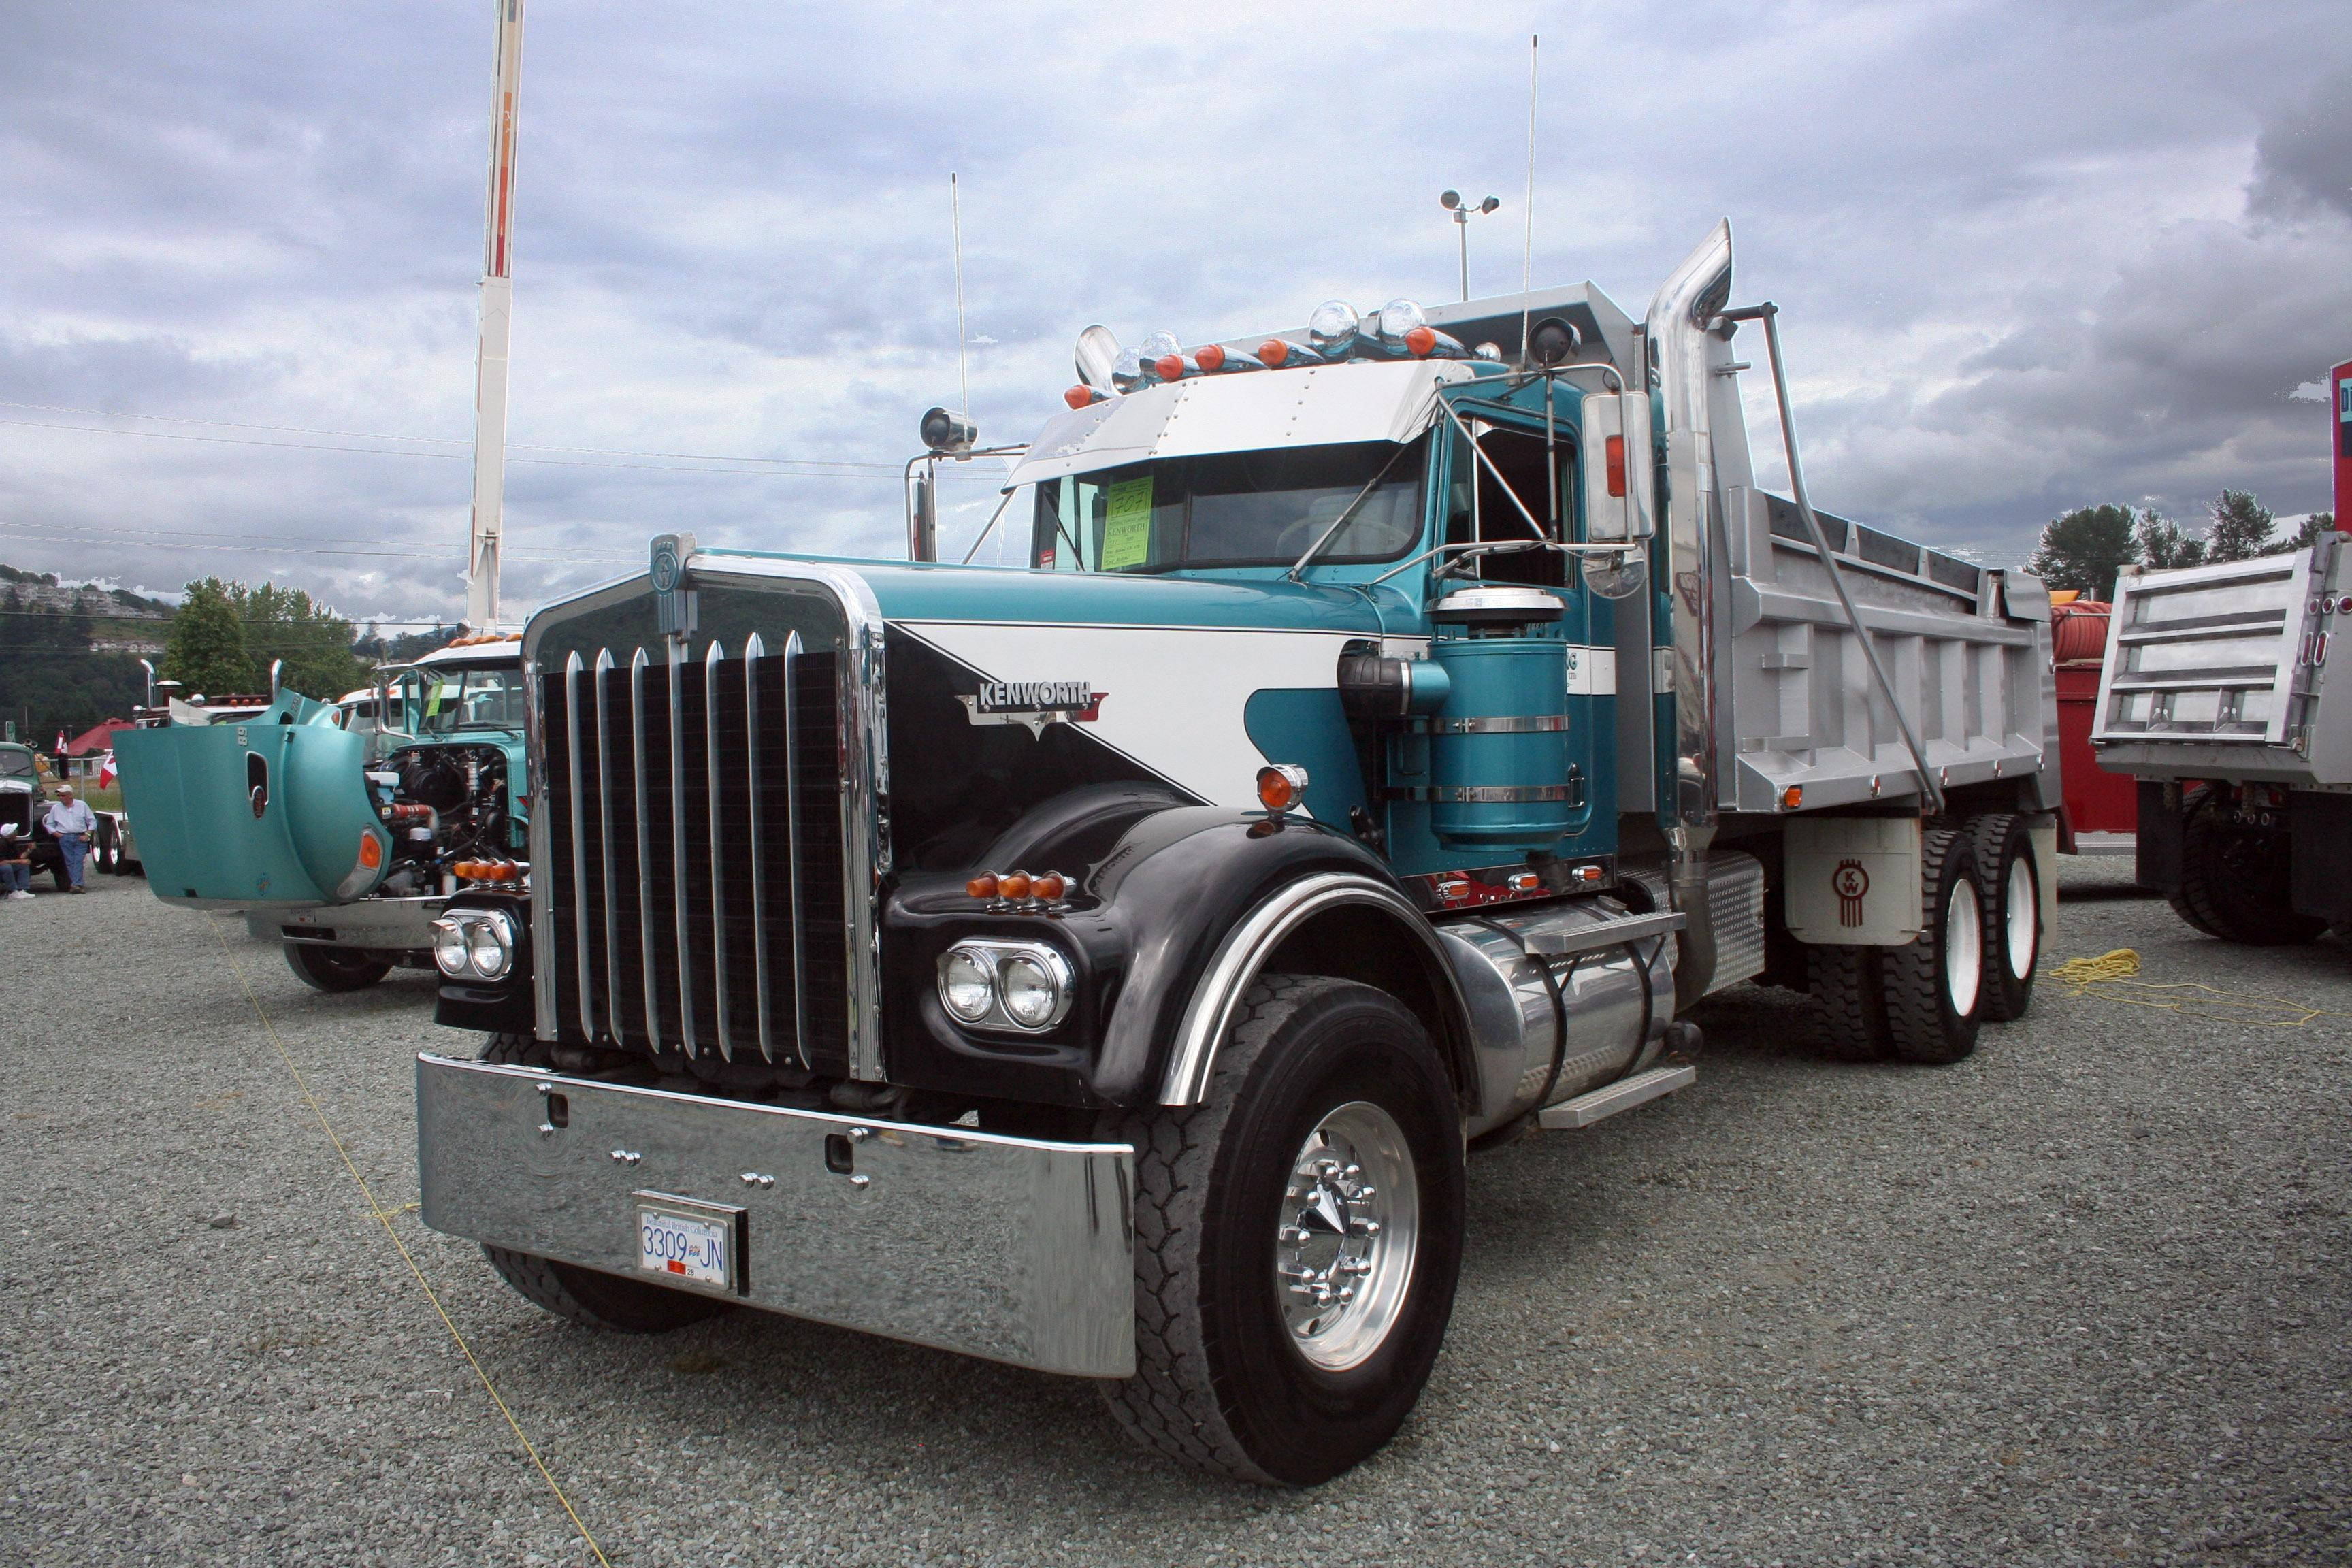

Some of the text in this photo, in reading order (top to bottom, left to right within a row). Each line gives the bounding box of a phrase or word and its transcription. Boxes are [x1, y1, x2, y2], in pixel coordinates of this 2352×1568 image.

[1115, 491, 1145, 516] 707
[1108, 523, 1145, 537] KENWORTH
[979, 681, 1091, 706] KENWORTH
[643, 1226, 687, 1261] 3309
[700, 1239, 723, 1271] JN
